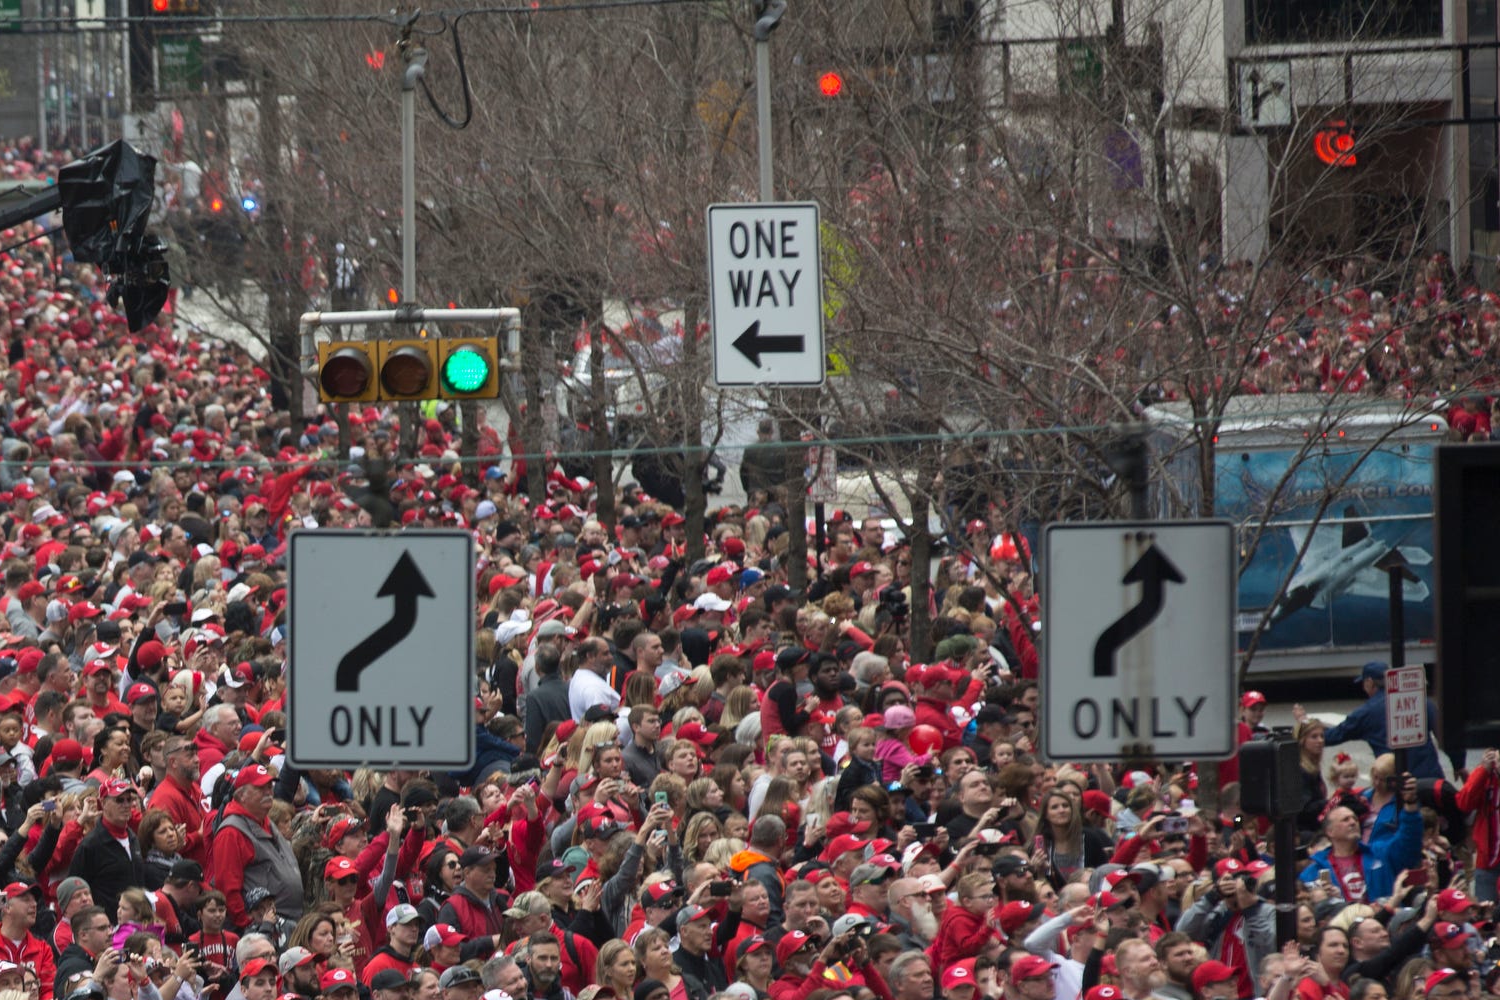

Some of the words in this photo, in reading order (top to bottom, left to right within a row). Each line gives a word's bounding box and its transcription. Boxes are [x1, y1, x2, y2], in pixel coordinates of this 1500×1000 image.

[729, 220, 799, 259] ONE
[729, 270, 802, 307] WAY
[1072, 696, 1207, 739] ONLY
[1394, 714, 1420, 730] TIME
[1396, 696, 1417, 712] ANY
[330, 704, 433, 747] ONLY
